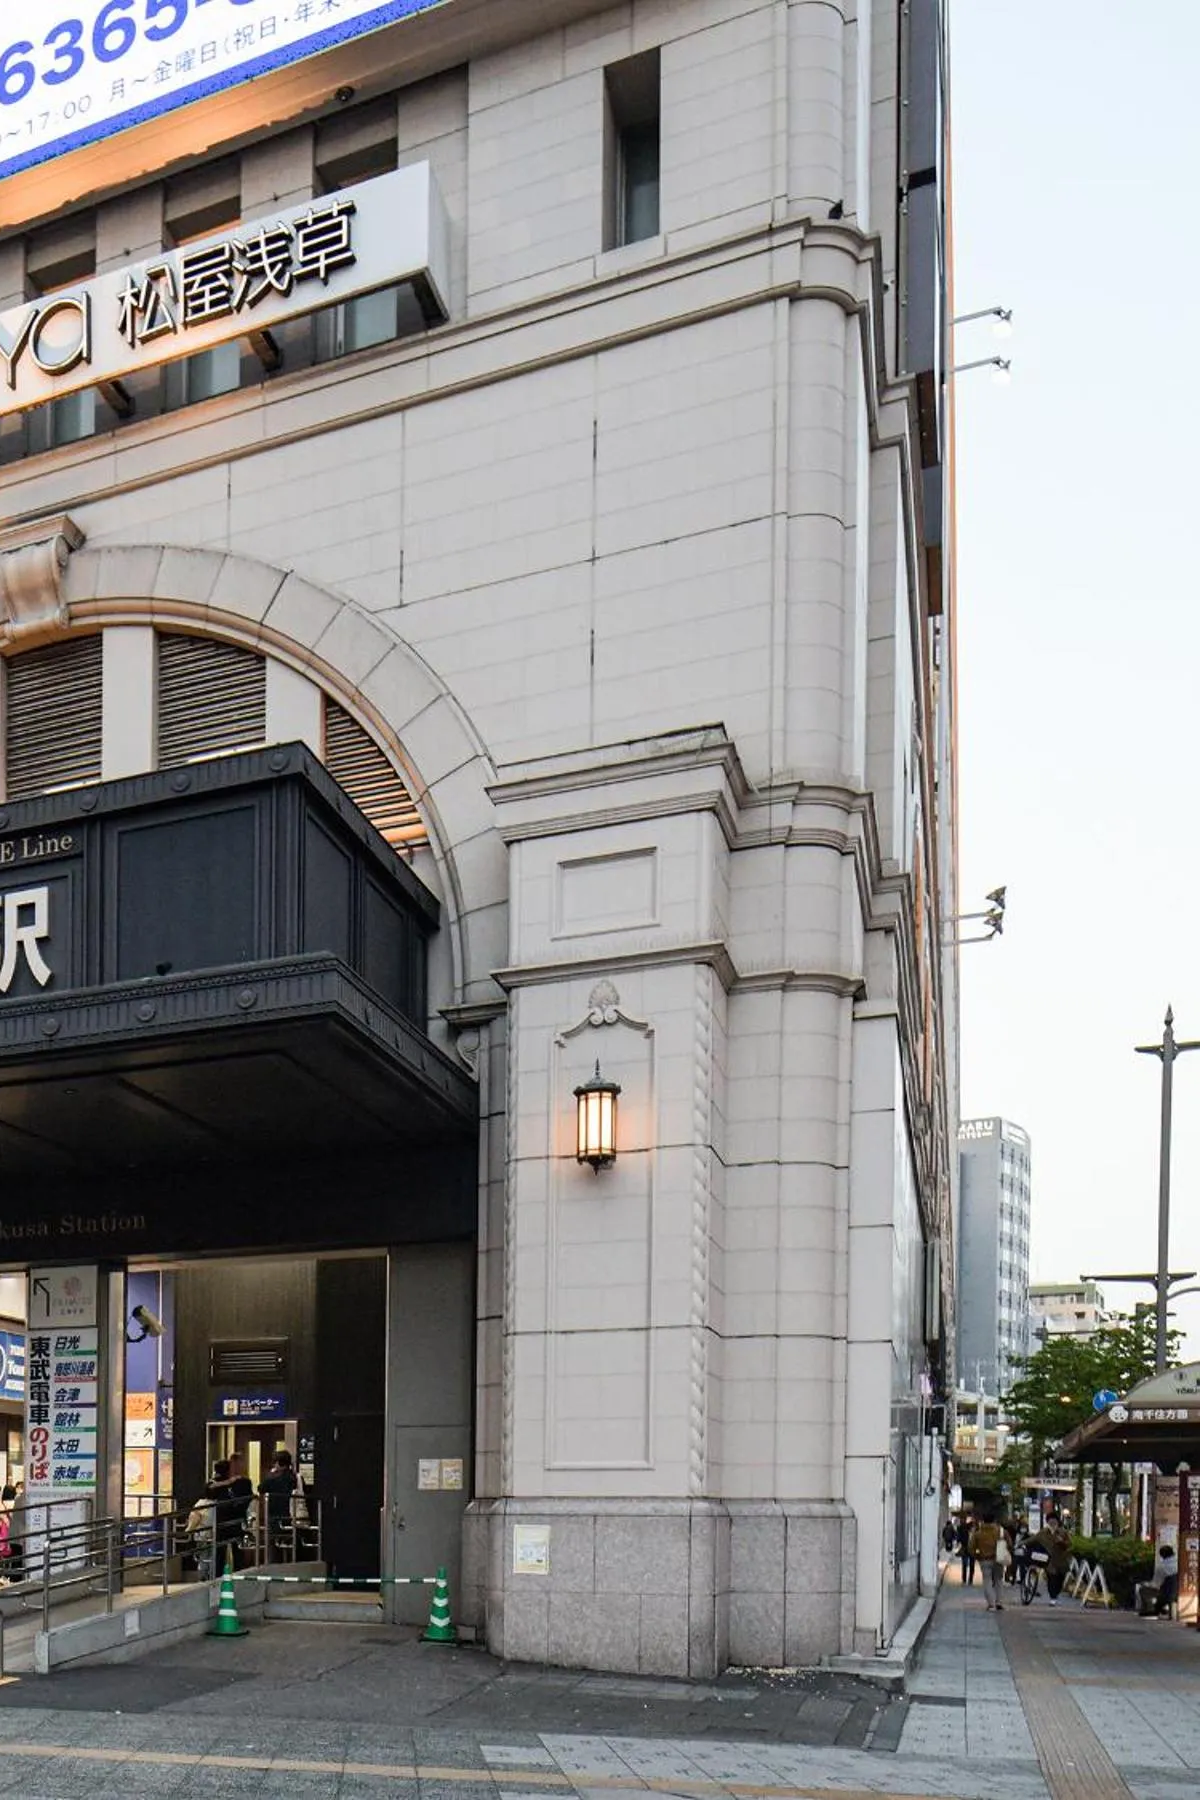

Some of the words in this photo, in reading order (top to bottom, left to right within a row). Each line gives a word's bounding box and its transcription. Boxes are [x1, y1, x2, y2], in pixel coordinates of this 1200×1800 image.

[117, 200, 357, 346] 松屋浅草
[21, 832, 73, 859] Line
[58, 1211, 146, 1236] Station
[54, 1335, 80, 1350] 日光
[54, 1387, 81, 1402] 会津
[29, 1336, 51, 1480] 東武電車のりば
[53, 1438, 80, 1453] 太田
